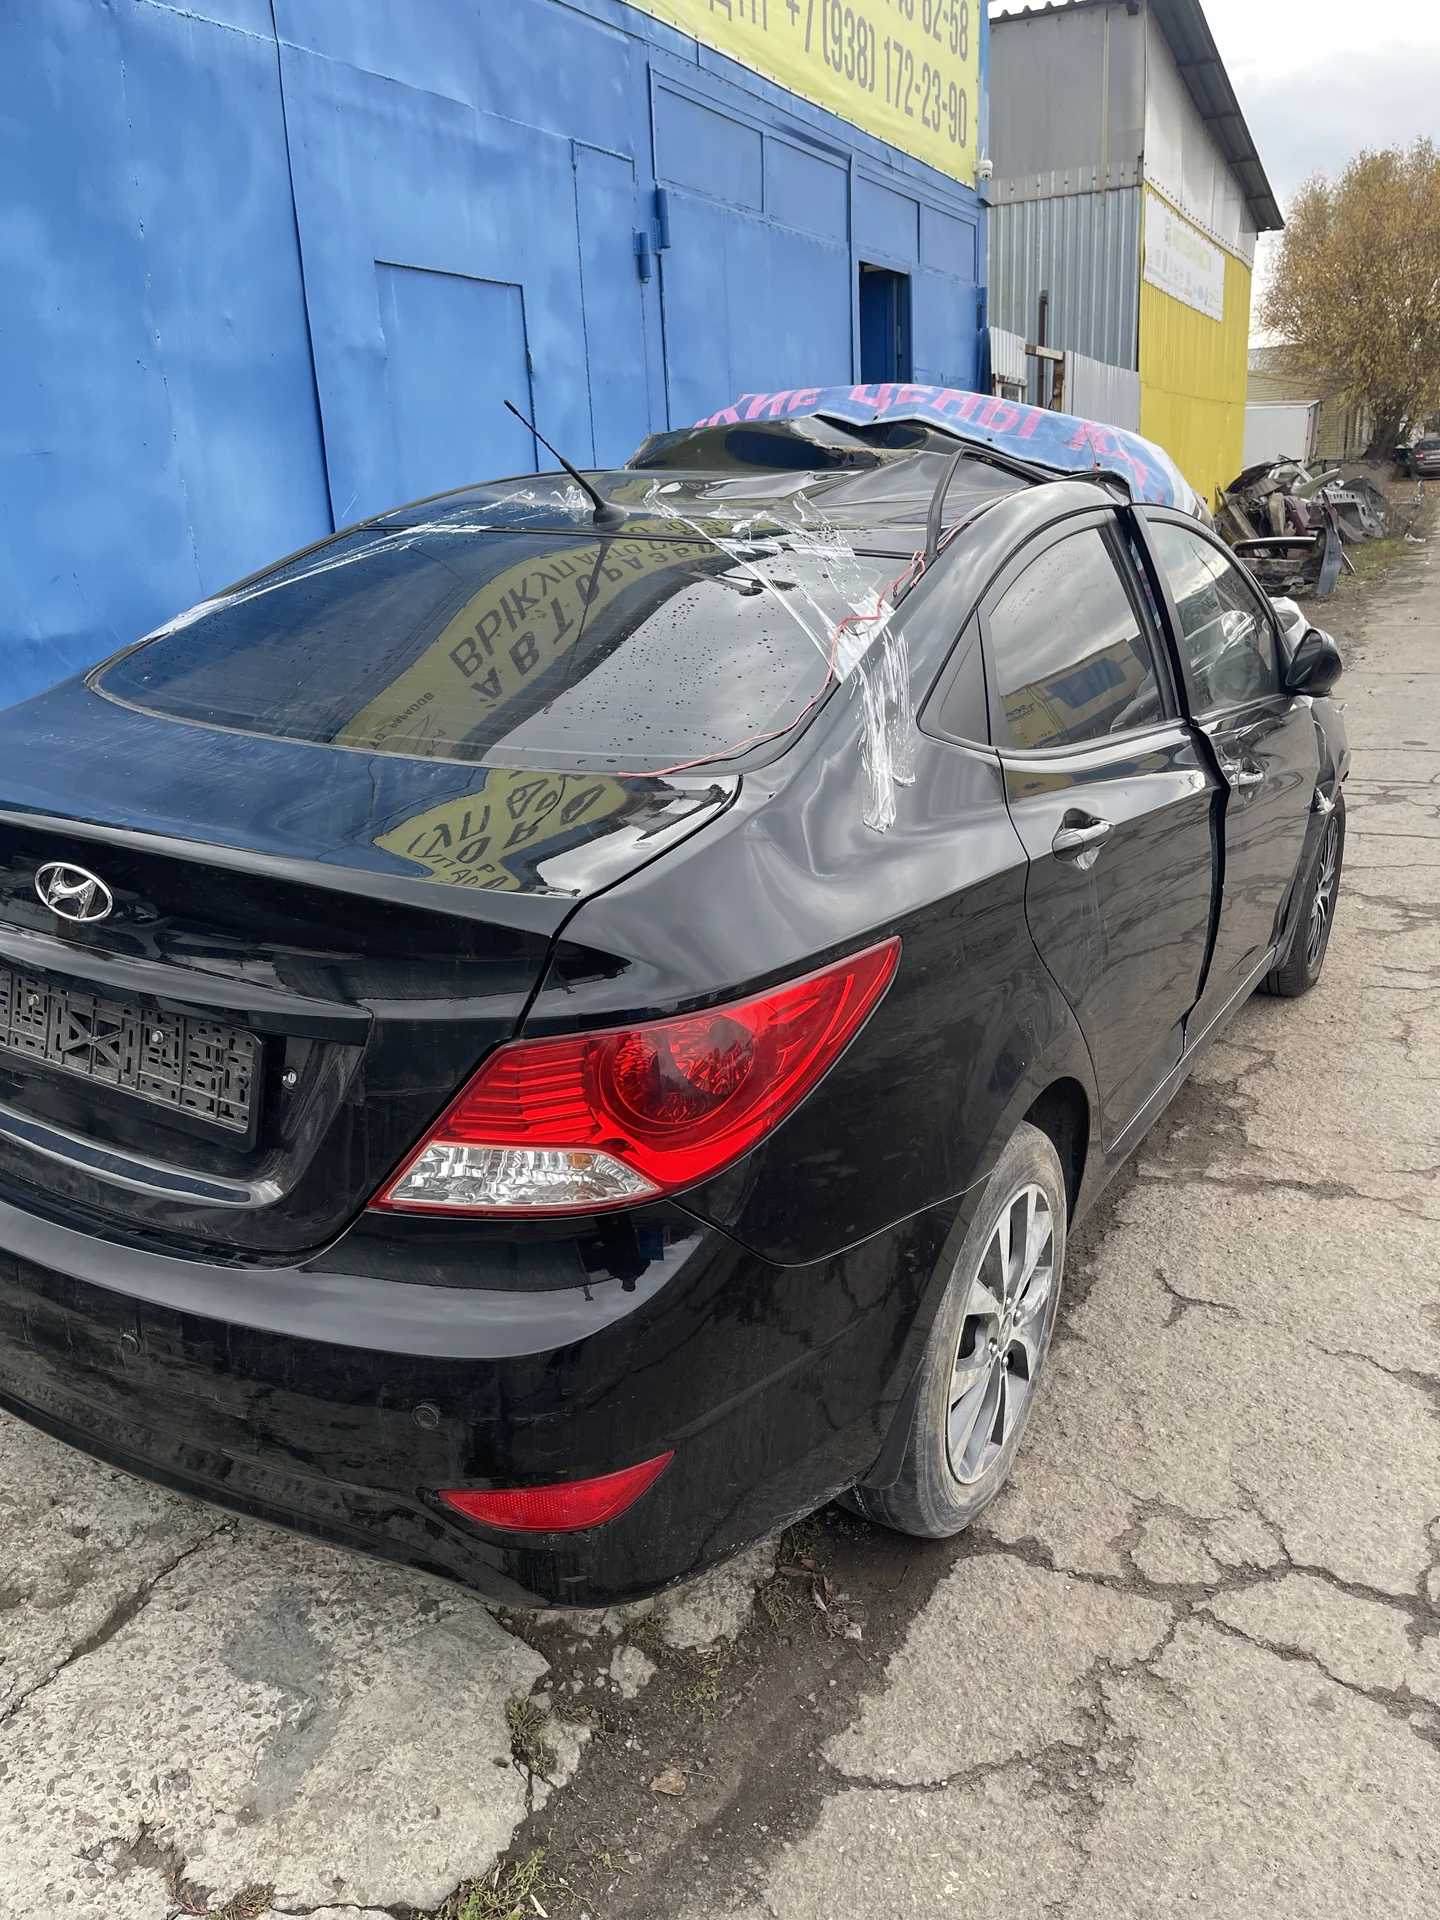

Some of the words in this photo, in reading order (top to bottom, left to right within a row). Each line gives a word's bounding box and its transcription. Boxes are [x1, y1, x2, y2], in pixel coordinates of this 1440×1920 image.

[886, 0, 968, 61] 62-58
[822, 0, 875, 92] (938)
[883, 36, 967, 149] 172-23-90
[693, 388, 823, 428] КИЕ
